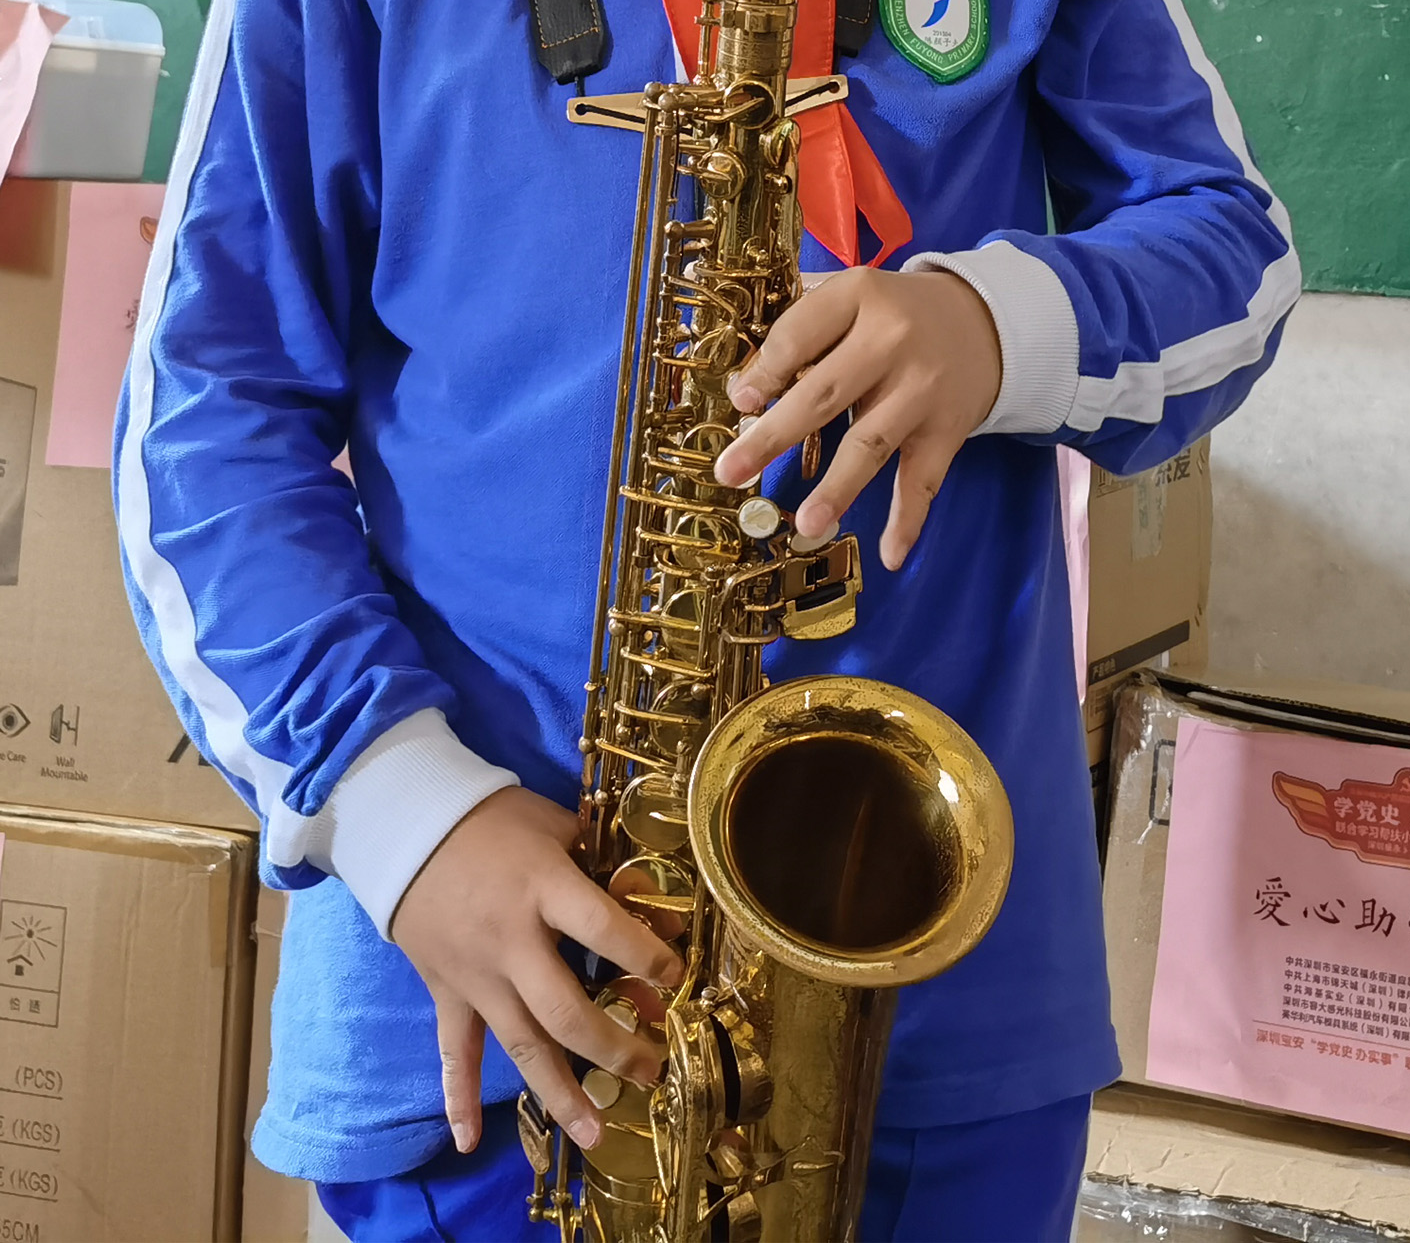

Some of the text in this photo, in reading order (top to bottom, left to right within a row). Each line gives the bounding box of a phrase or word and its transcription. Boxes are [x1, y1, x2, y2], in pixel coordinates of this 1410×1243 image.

[909, 38, 944, 65] FUYONG
[947, 34, 975, 62] PRIMARY
[1333, 796, 1401, 827] 学党史
[15, 1065, 64, 1093] (PCS)
[12, 1118, 61, 1146] (KGS)
[9, 1168, 59, 1196] (KGS)
[0, 1219, 39, 1243] 5CM
